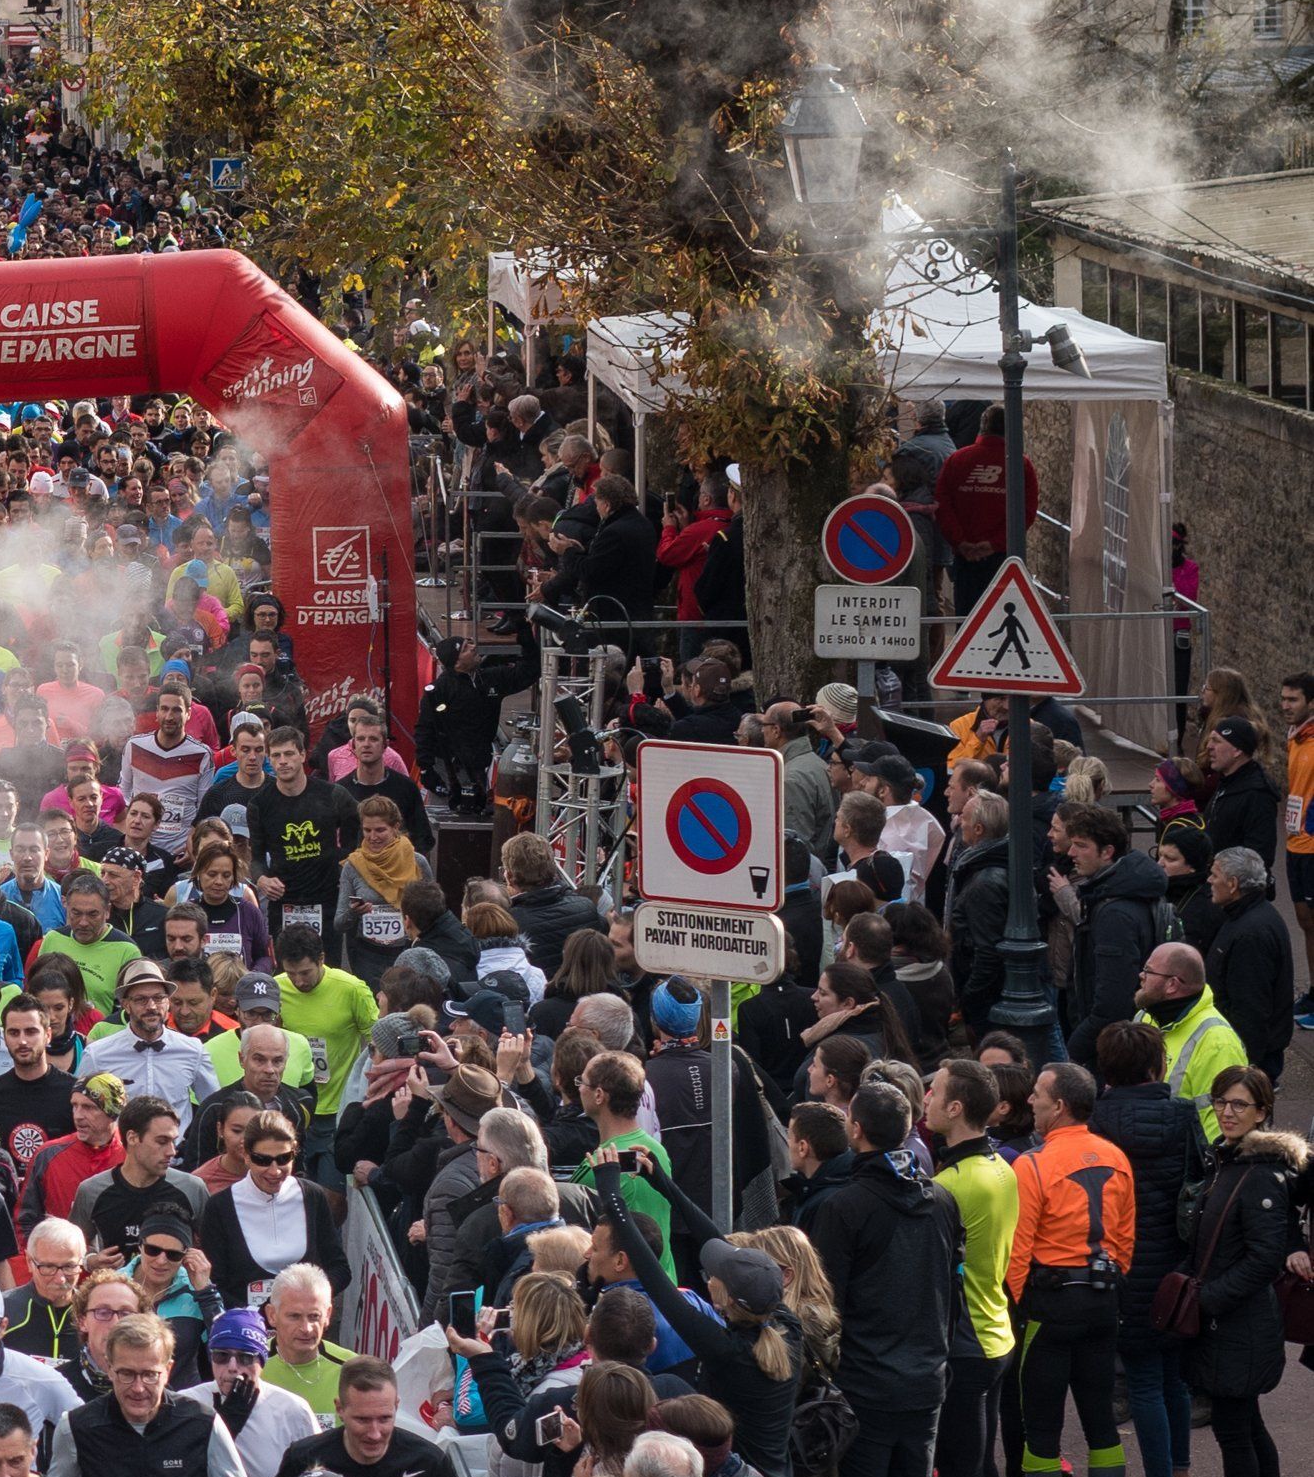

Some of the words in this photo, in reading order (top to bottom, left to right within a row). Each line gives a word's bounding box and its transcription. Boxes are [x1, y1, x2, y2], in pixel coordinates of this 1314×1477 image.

[0, 299, 100, 328] CAISSE
[236, 358, 314, 404] running
[836, 596, 902, 609] INTERDIT
[831, 614, 848, 627] LE
[853, 614, 907, 627] SAMEDI
[819, 634, 833, 645] DE
[837, 634, 866, 646] 5H00
[880, 635, 916, 646] 14H00
[285, 843, 321, 854] DIJON
[365, 921, 401, 934] 3579
[657, 910, 754, 935] STATIONNEMENT
[645, 928, 687, 949] PAYANT
[691, 934, 767, 956] HORODATEUR
